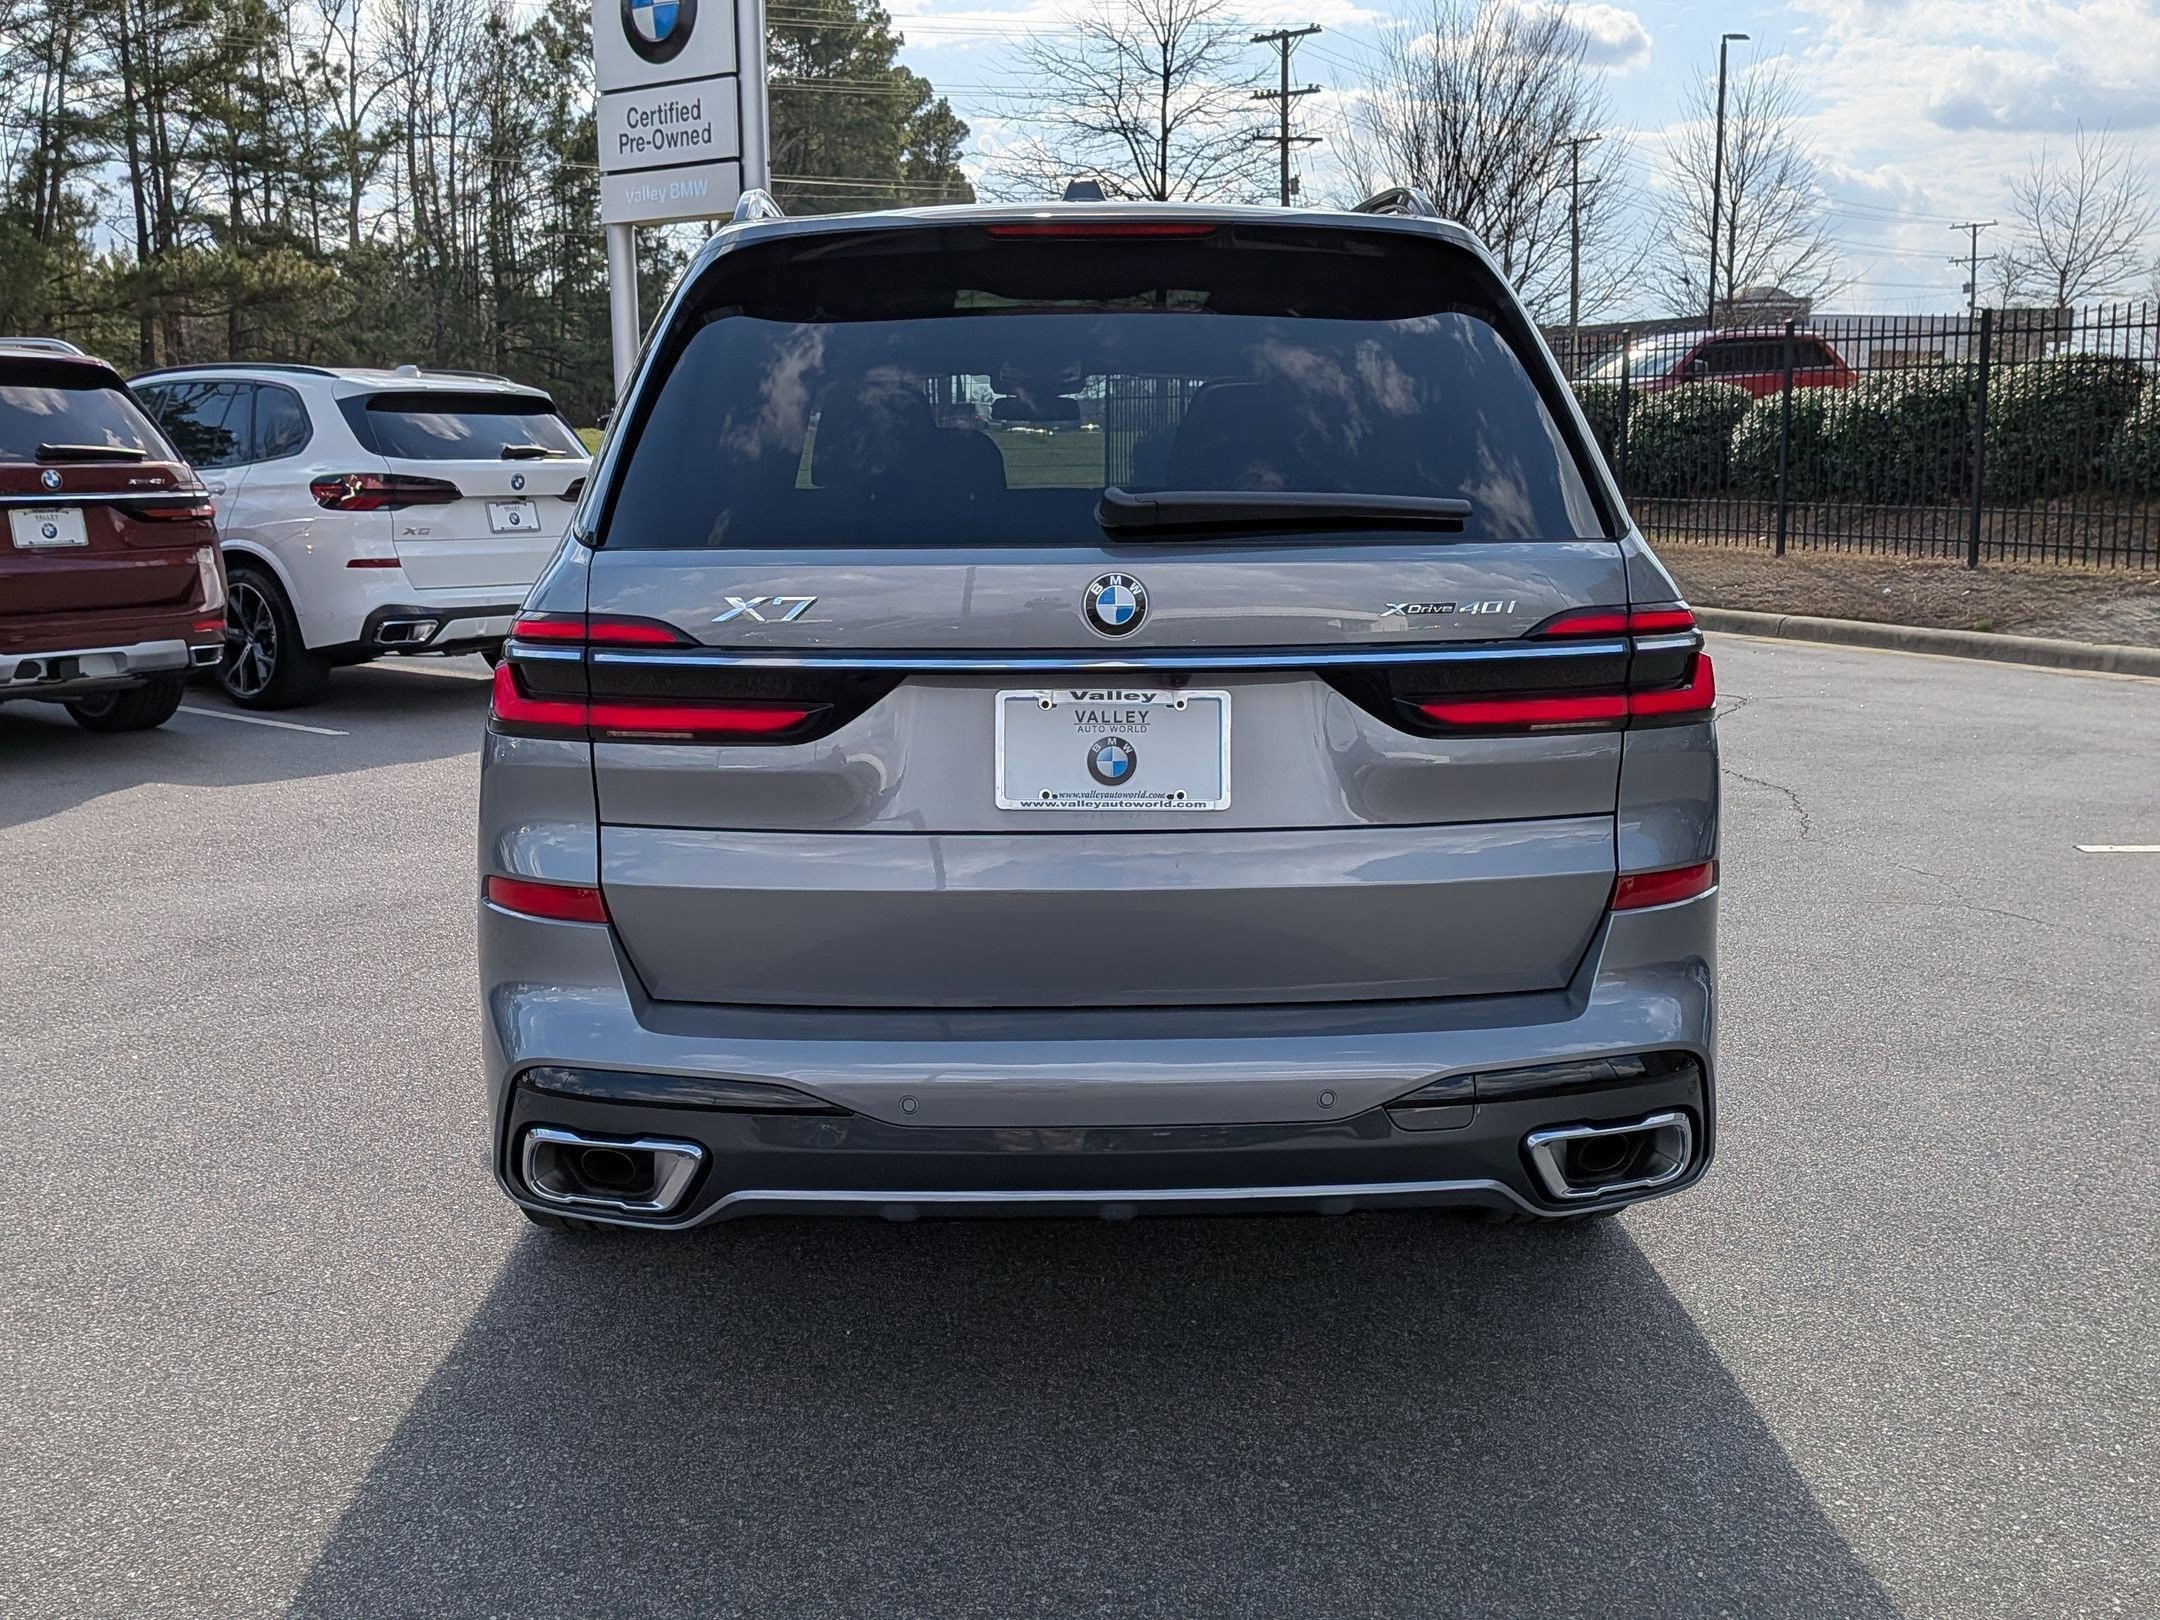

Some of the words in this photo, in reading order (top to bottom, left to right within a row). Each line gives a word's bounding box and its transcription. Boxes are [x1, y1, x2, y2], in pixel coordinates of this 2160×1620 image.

[627, 98, 701, 129] Certified
[619, 122, 712, 154] Pre-Owned
[625, 185, 667, 205] Valley
[670, 179, 708, 200] BMW
[1090, 575, 1142, 595] BMW
[712, 596, 817, 622] X7
[1069, 691, 1157, 704] Valley
[1074, 710, 1151, 723] VALLEY
[1077, 725, 1105, 733] AUTO
[1109, 725, 1147, 733] WORLD
[1092, 737, 1133, 753] BMW
[1059, 790, 1166, 800] www.valleyautoworld.com
[1020, 800, 1207, 809] www.valleyautoworld.com
